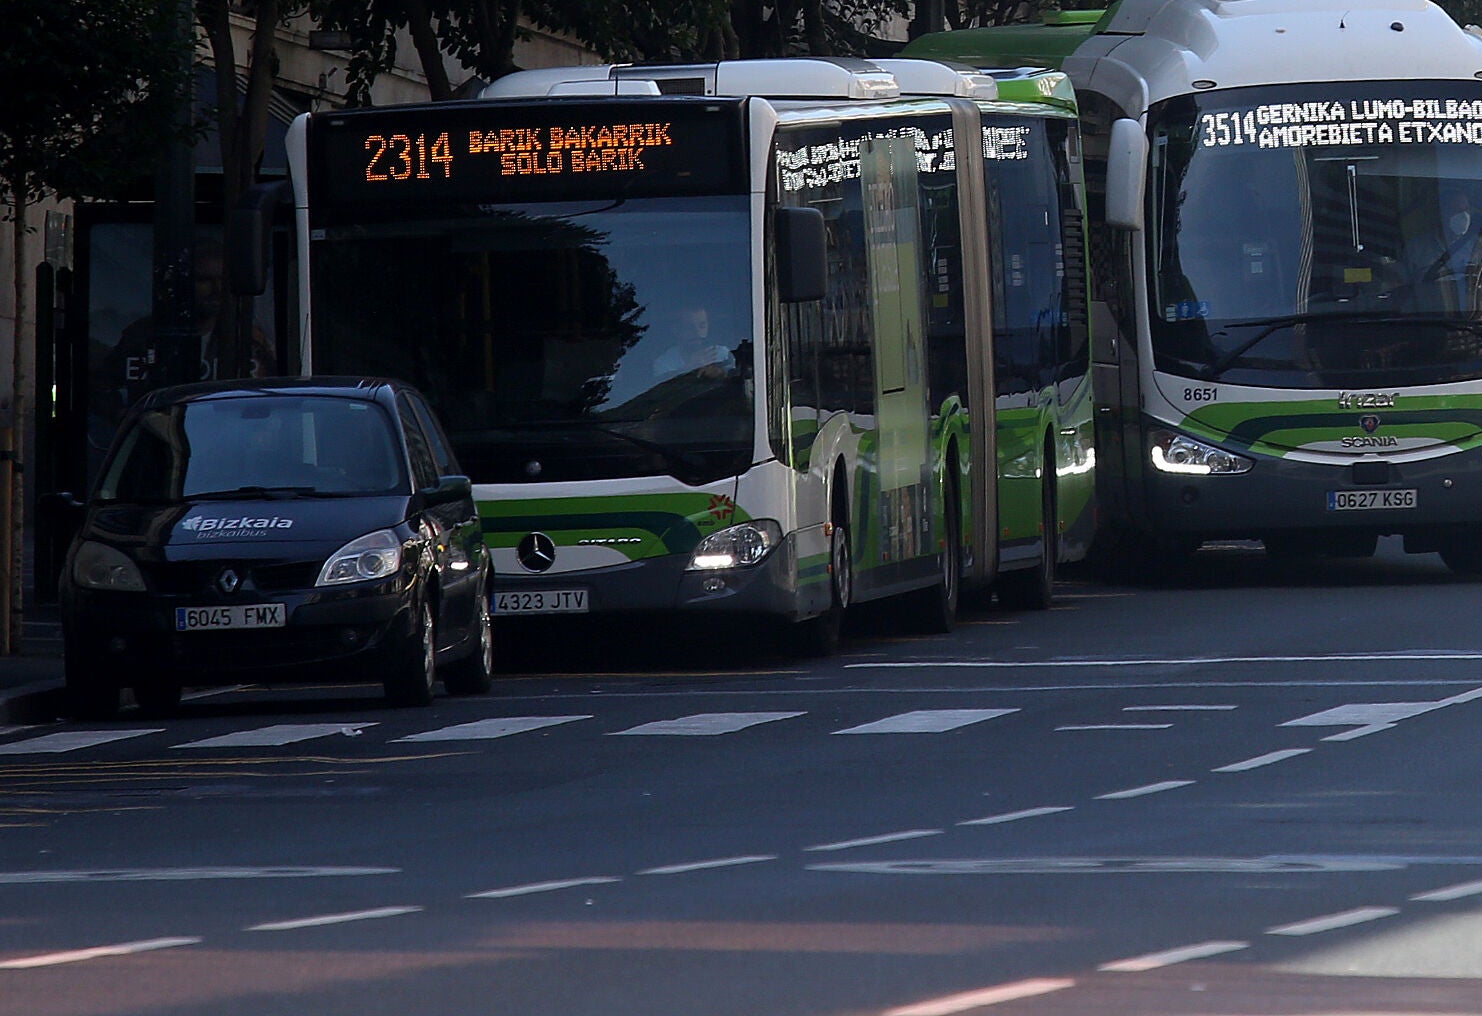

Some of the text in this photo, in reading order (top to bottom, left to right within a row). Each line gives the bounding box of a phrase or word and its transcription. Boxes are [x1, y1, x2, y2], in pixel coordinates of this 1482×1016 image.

[1257, 103, 1345, 125] GERNIKA
[468, 122, 672, 154] BARIK BAKARRIK
[1201, 111, 1257, 146] 3514
[1259, 122, 1393, 148] AMOREBIETA
[364, 131, 454, 182] 2314
[501, 147, 644, 176] SOLO BARIK
[1183, 387, 1219, 402] 8651
[1341, 436, 1399, 448] SCANIA
[1337, 490, 1414, 508] 0627 KSG
[196, 528, 268, 539] bizkaibus
[199, 516, 293, 532] Bizkaia
[498, 591, 584, 611] 4323 JTV
[188, 606, 279, 628] 6045 FMX
